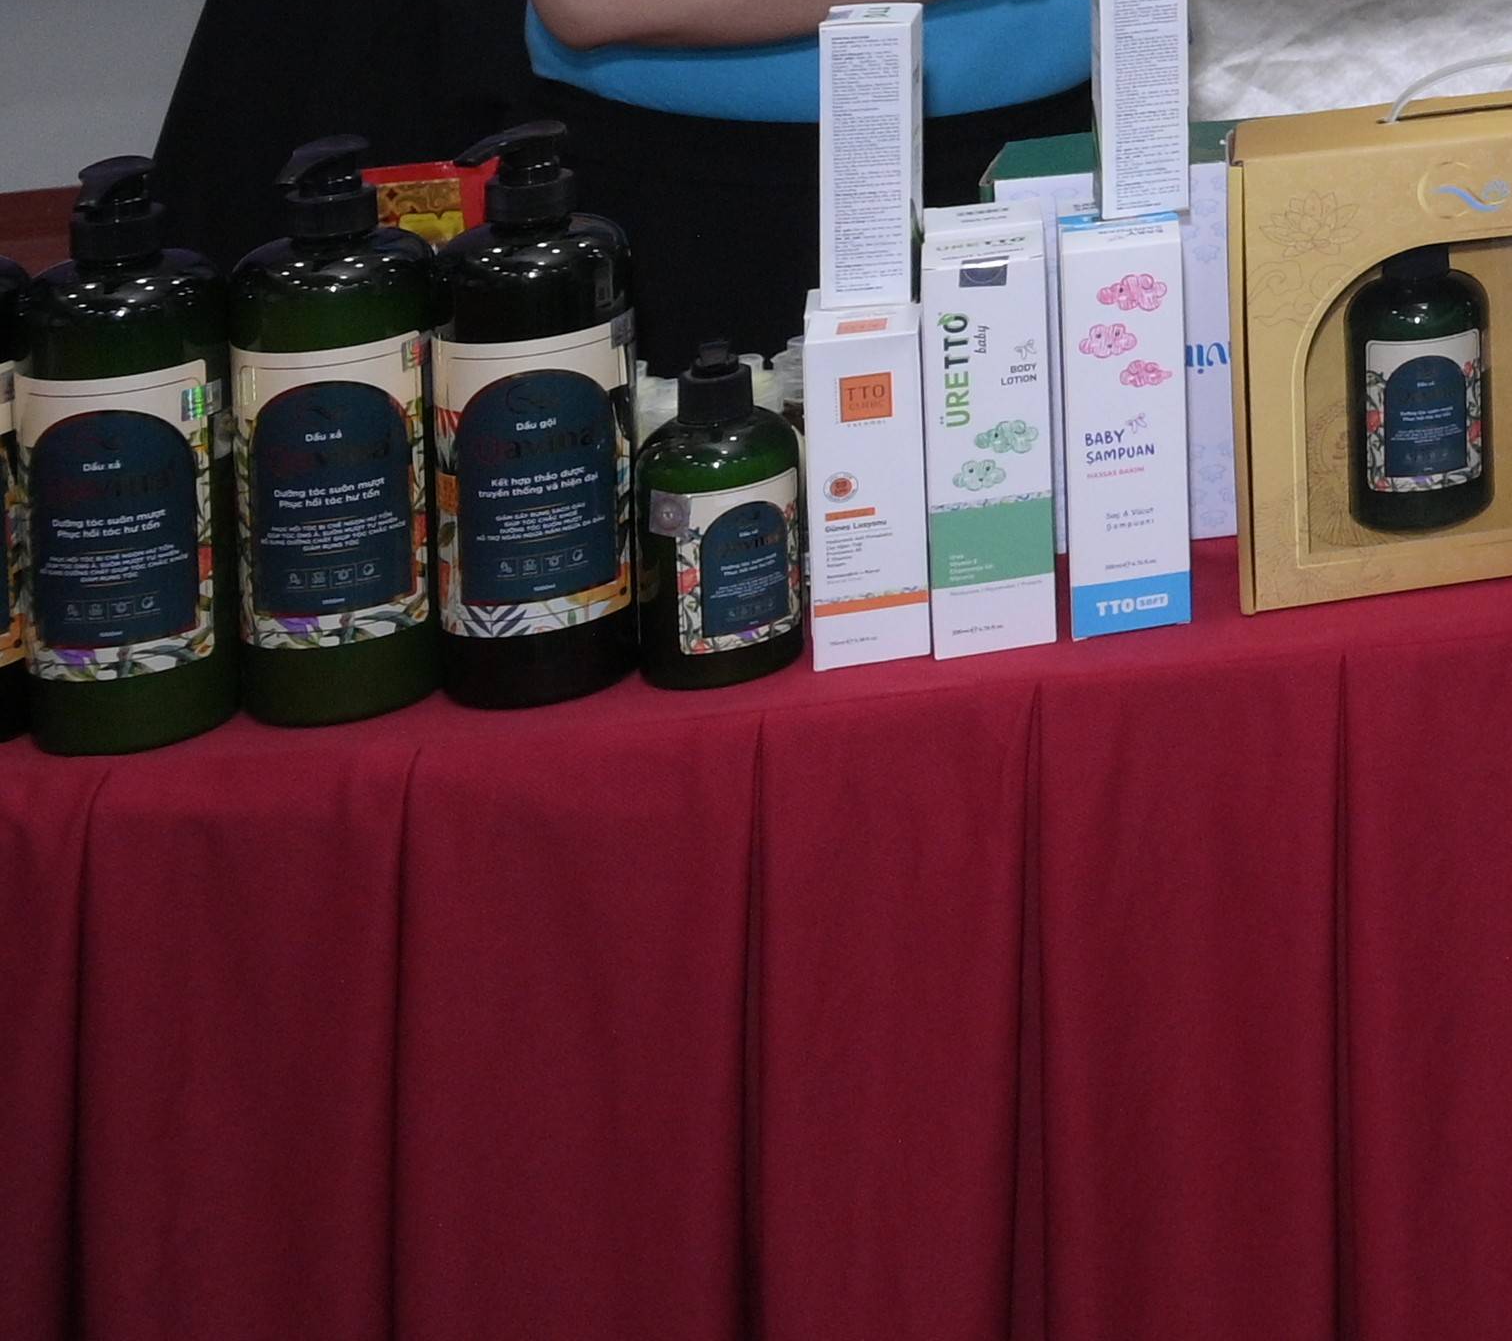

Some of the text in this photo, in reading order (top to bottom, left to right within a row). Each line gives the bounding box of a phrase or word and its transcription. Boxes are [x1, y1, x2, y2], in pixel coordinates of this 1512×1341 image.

[974, 325, 990, 354] baby
[1010, 362, 1038, 374] BODY
[1000, 374, 1038, 386] LOTION
[843, 383, 887, 402] TTO
[1085, 429, 1126, 447] BABY
[1096, 598, 1136, 618] TTO
